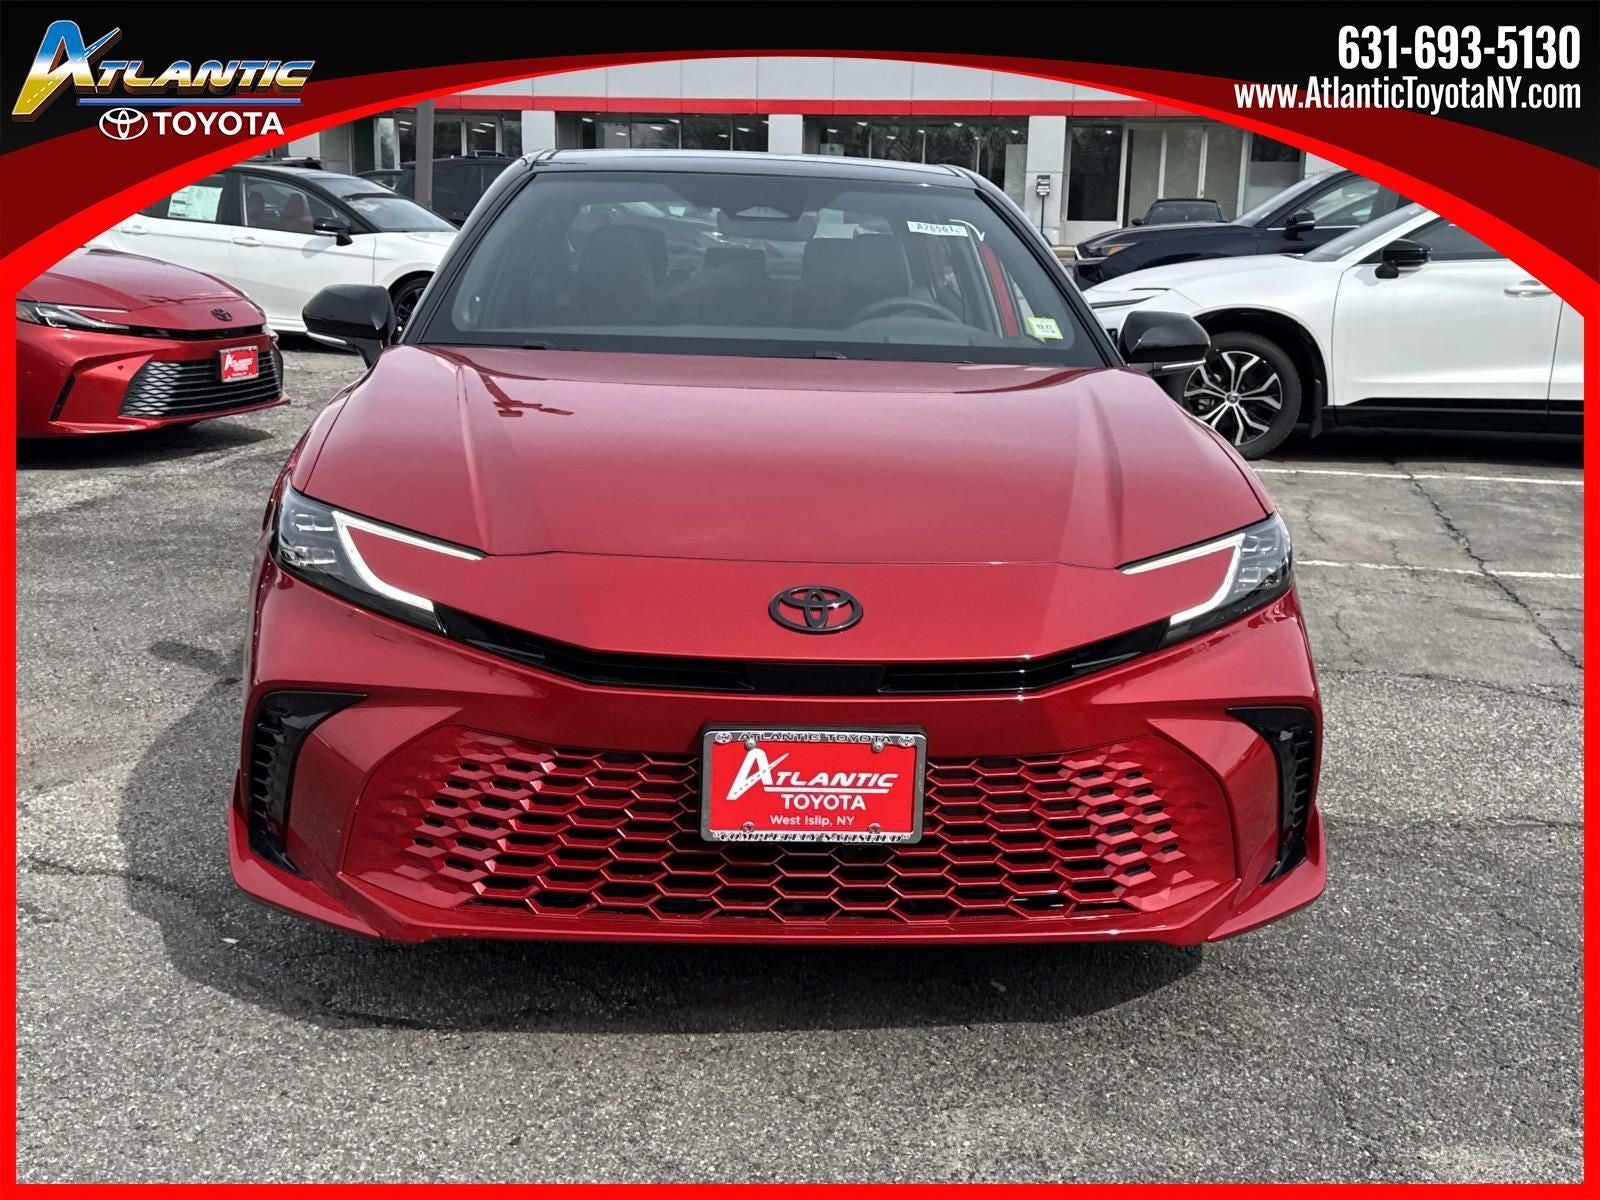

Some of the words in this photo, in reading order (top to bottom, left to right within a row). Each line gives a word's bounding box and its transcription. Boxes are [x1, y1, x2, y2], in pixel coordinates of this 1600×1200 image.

[737, 732, 821, 743] ATLANTIC
[825, 733, 893, 745] TOYOTA
[726, 748, 899, 800] ATLANTIC
[780, 793, 867, 811] TOYOTA
[769, 815, 801, 826] West
[804, 815, 832, 828] Islip,
[836, 816, 855, 826] NY
